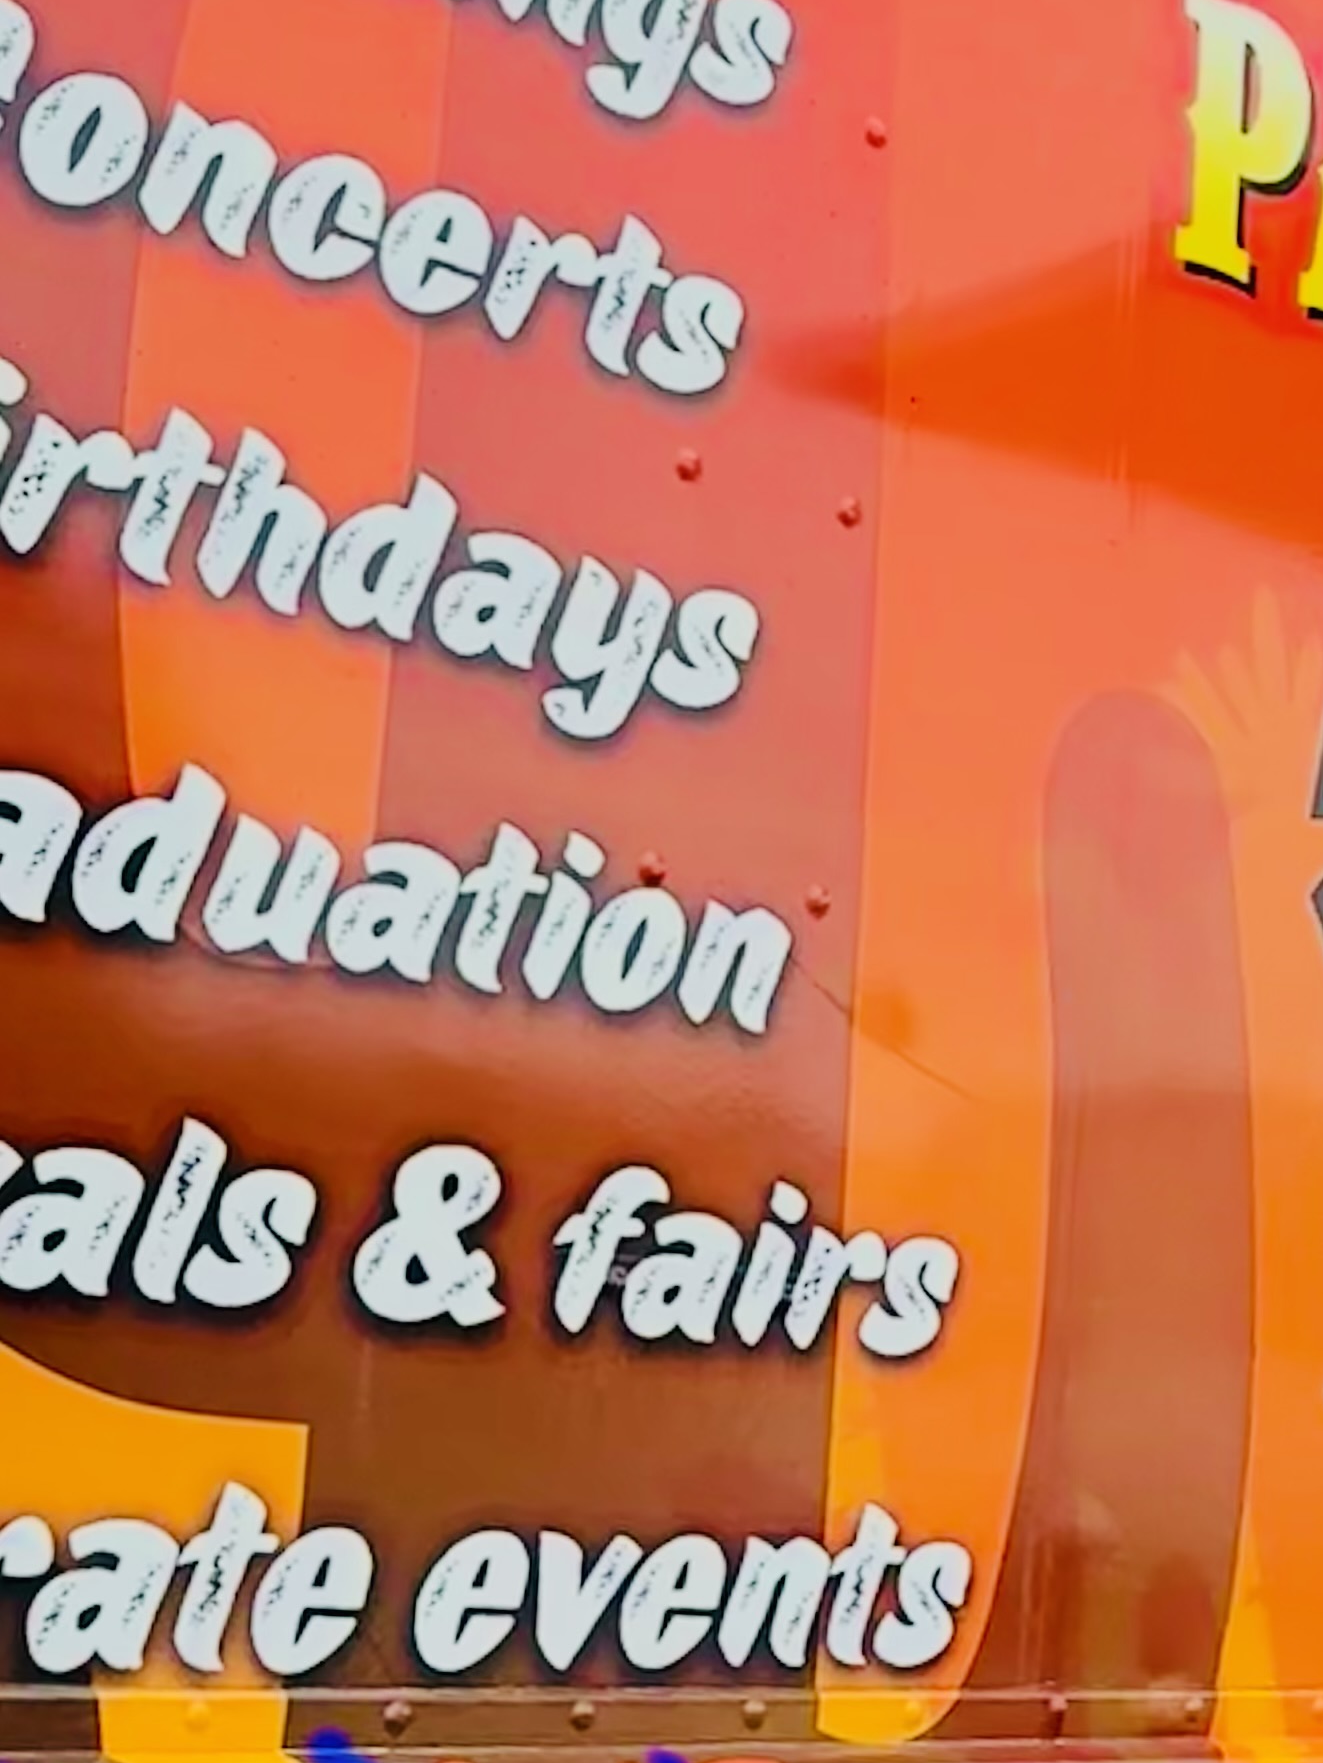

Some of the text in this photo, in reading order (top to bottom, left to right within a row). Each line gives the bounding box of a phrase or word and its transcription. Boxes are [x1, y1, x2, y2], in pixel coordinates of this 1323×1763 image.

[0, 1116, 960, 1359] als & fairs
[412, 1501, 973, 1675] events
